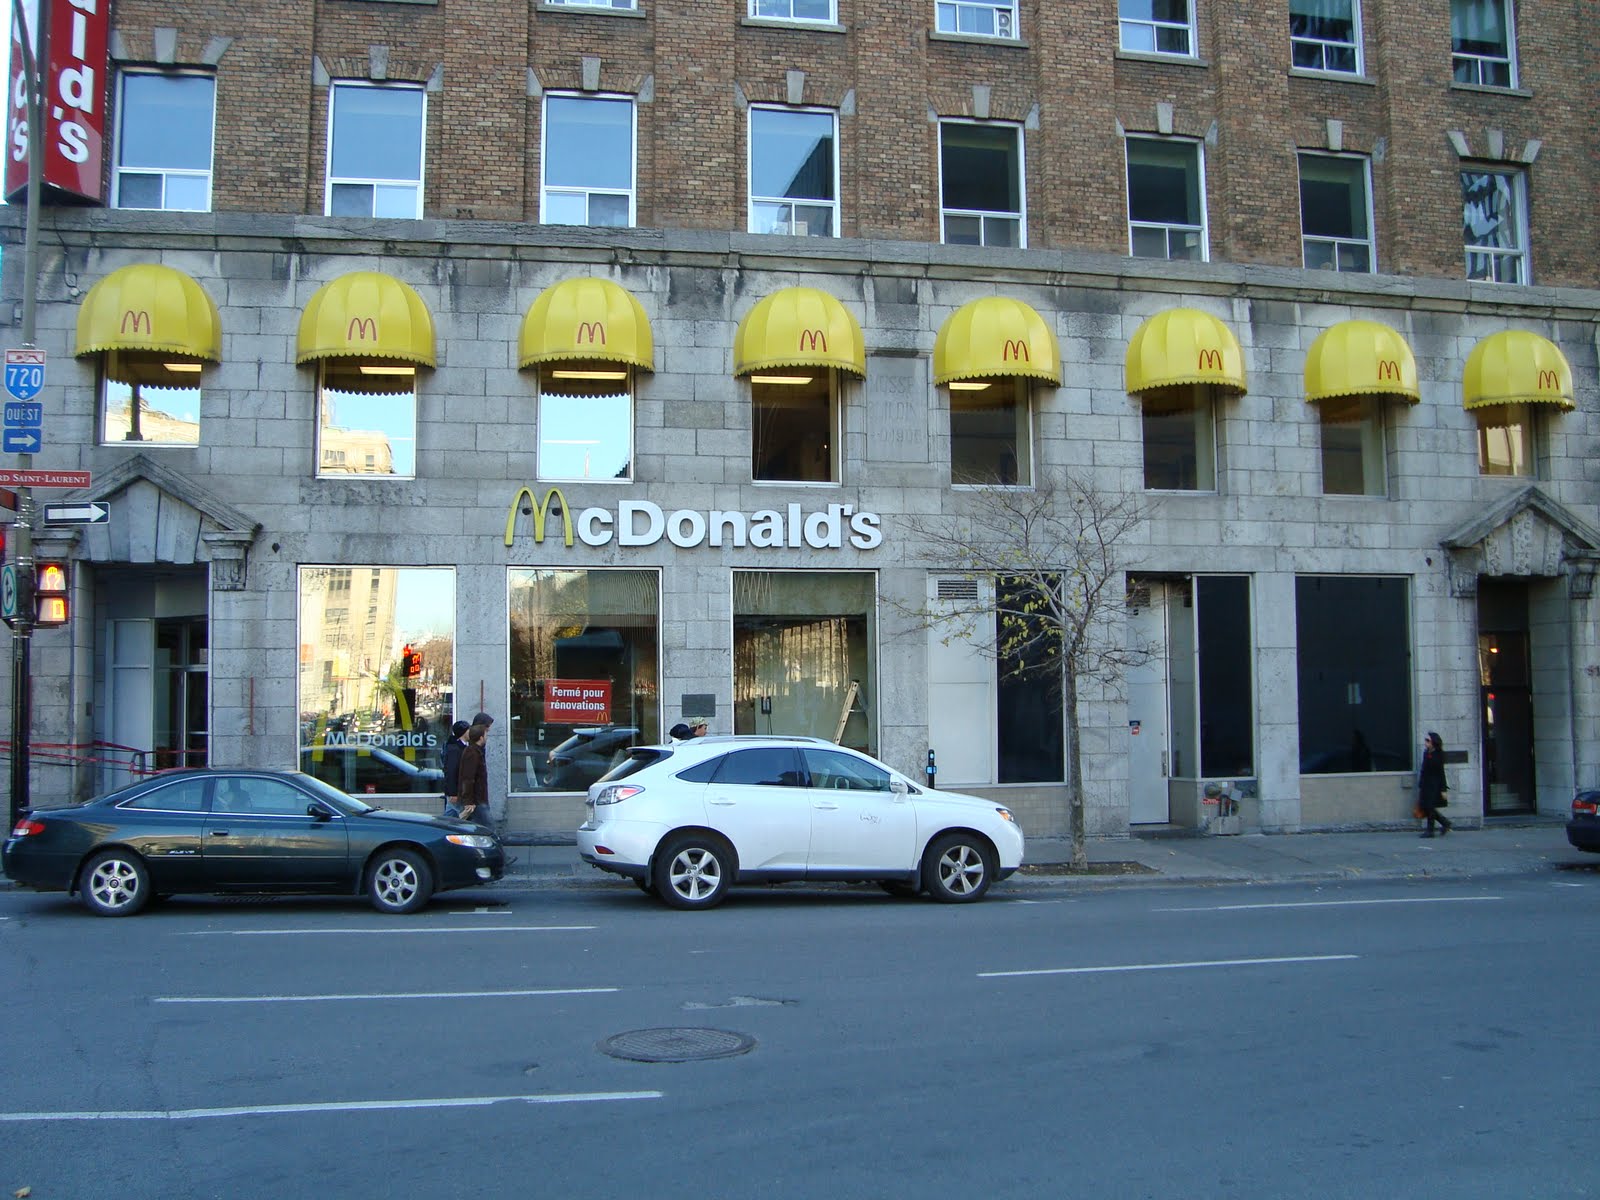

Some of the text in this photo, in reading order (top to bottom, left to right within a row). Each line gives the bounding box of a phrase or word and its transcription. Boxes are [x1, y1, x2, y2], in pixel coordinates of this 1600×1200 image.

[8, 367, 42, 388] 720
[6, 408, 40, 421] OUEST
[13, 473, 87, 484] SAINT-LAURENT
[504, 485, 883, 550] McDonald's
[551, 685, 605, 699] Fermé pour
[550, 699, 605, 711] rénovations
[326, 731, 437, 747] McDonald's
